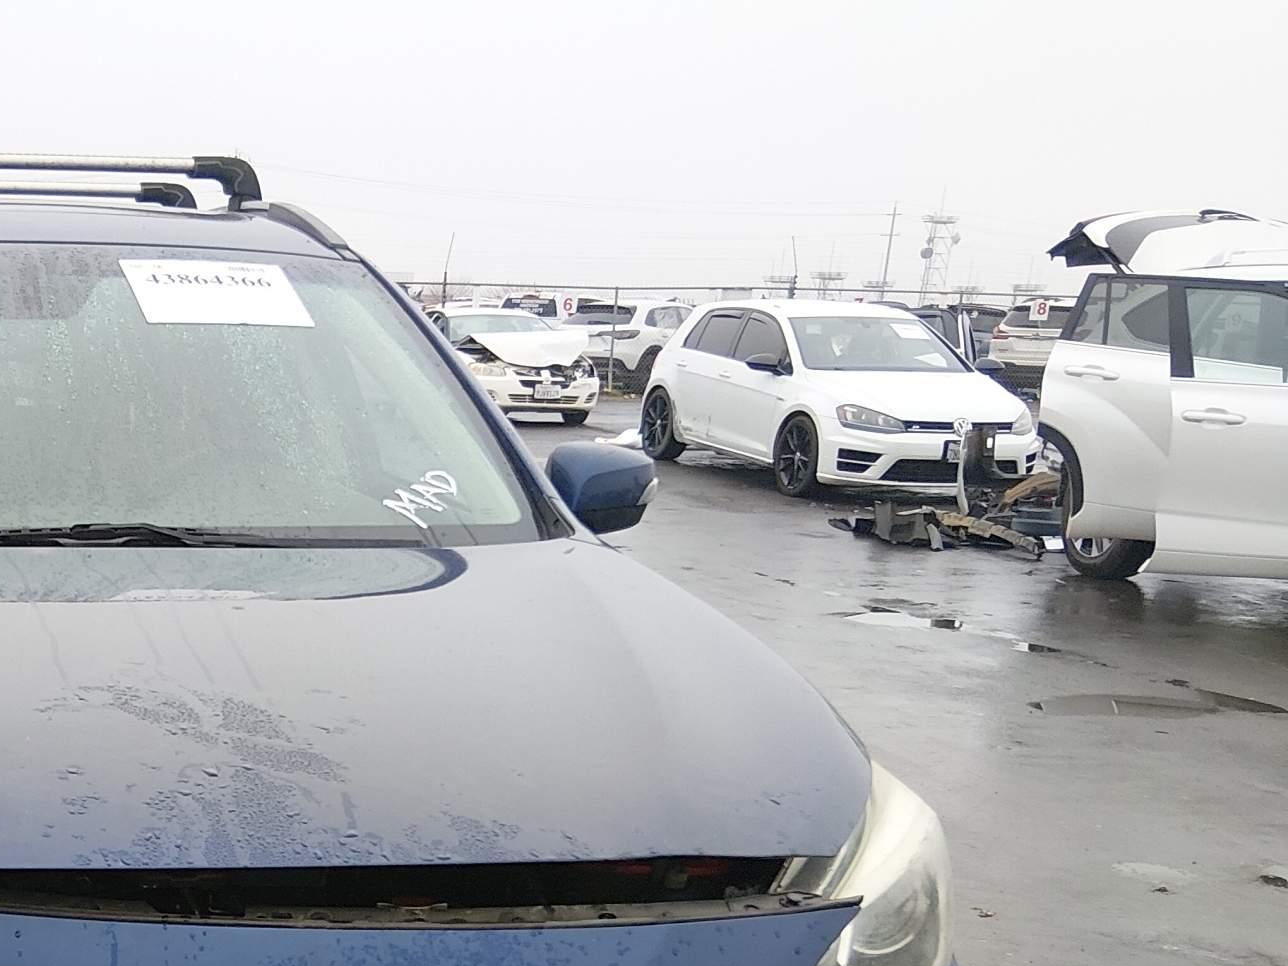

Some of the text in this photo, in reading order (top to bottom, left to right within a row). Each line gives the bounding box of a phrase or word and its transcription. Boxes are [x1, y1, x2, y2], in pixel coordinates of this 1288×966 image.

[145, 273, 272, 287] 43864366
[563, 297, 574, 312] 6
[1037, 302, 1047, 315] 8
[382, 470, 458, 529] MAD
